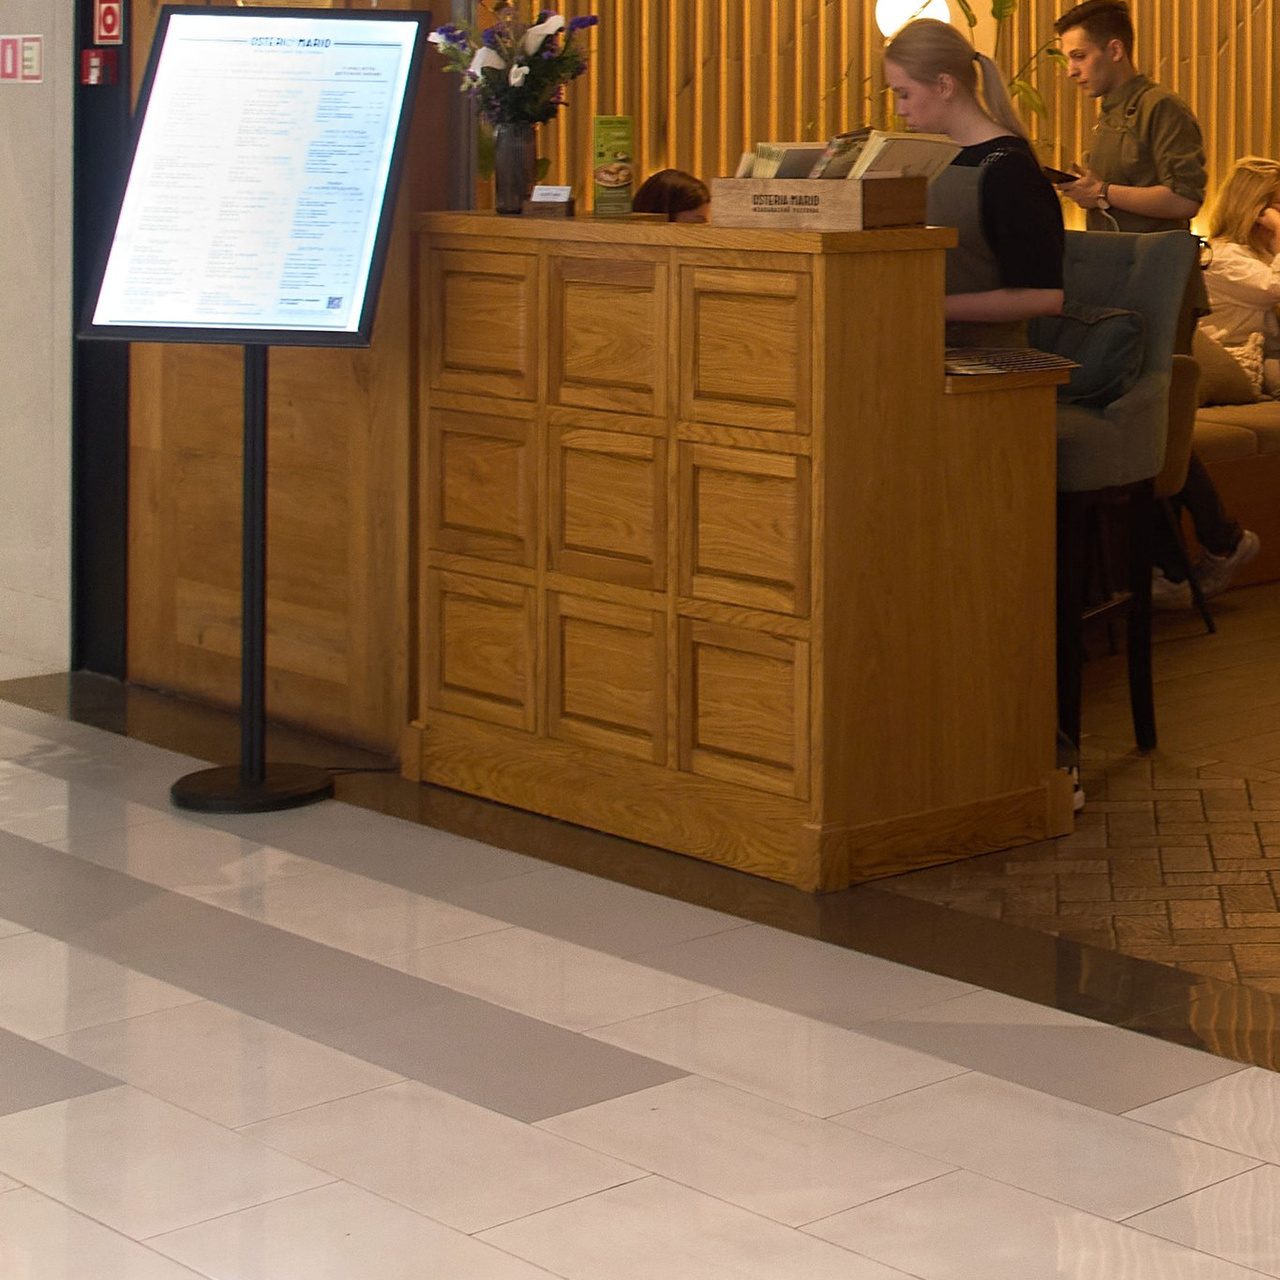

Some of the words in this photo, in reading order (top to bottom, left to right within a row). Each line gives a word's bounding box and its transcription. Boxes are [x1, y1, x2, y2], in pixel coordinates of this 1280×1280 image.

[298, 38, 332, 48] MARIO
[752, 194, 789, 205] OSTERIA
[790, 195, 820, 206] MARIO
